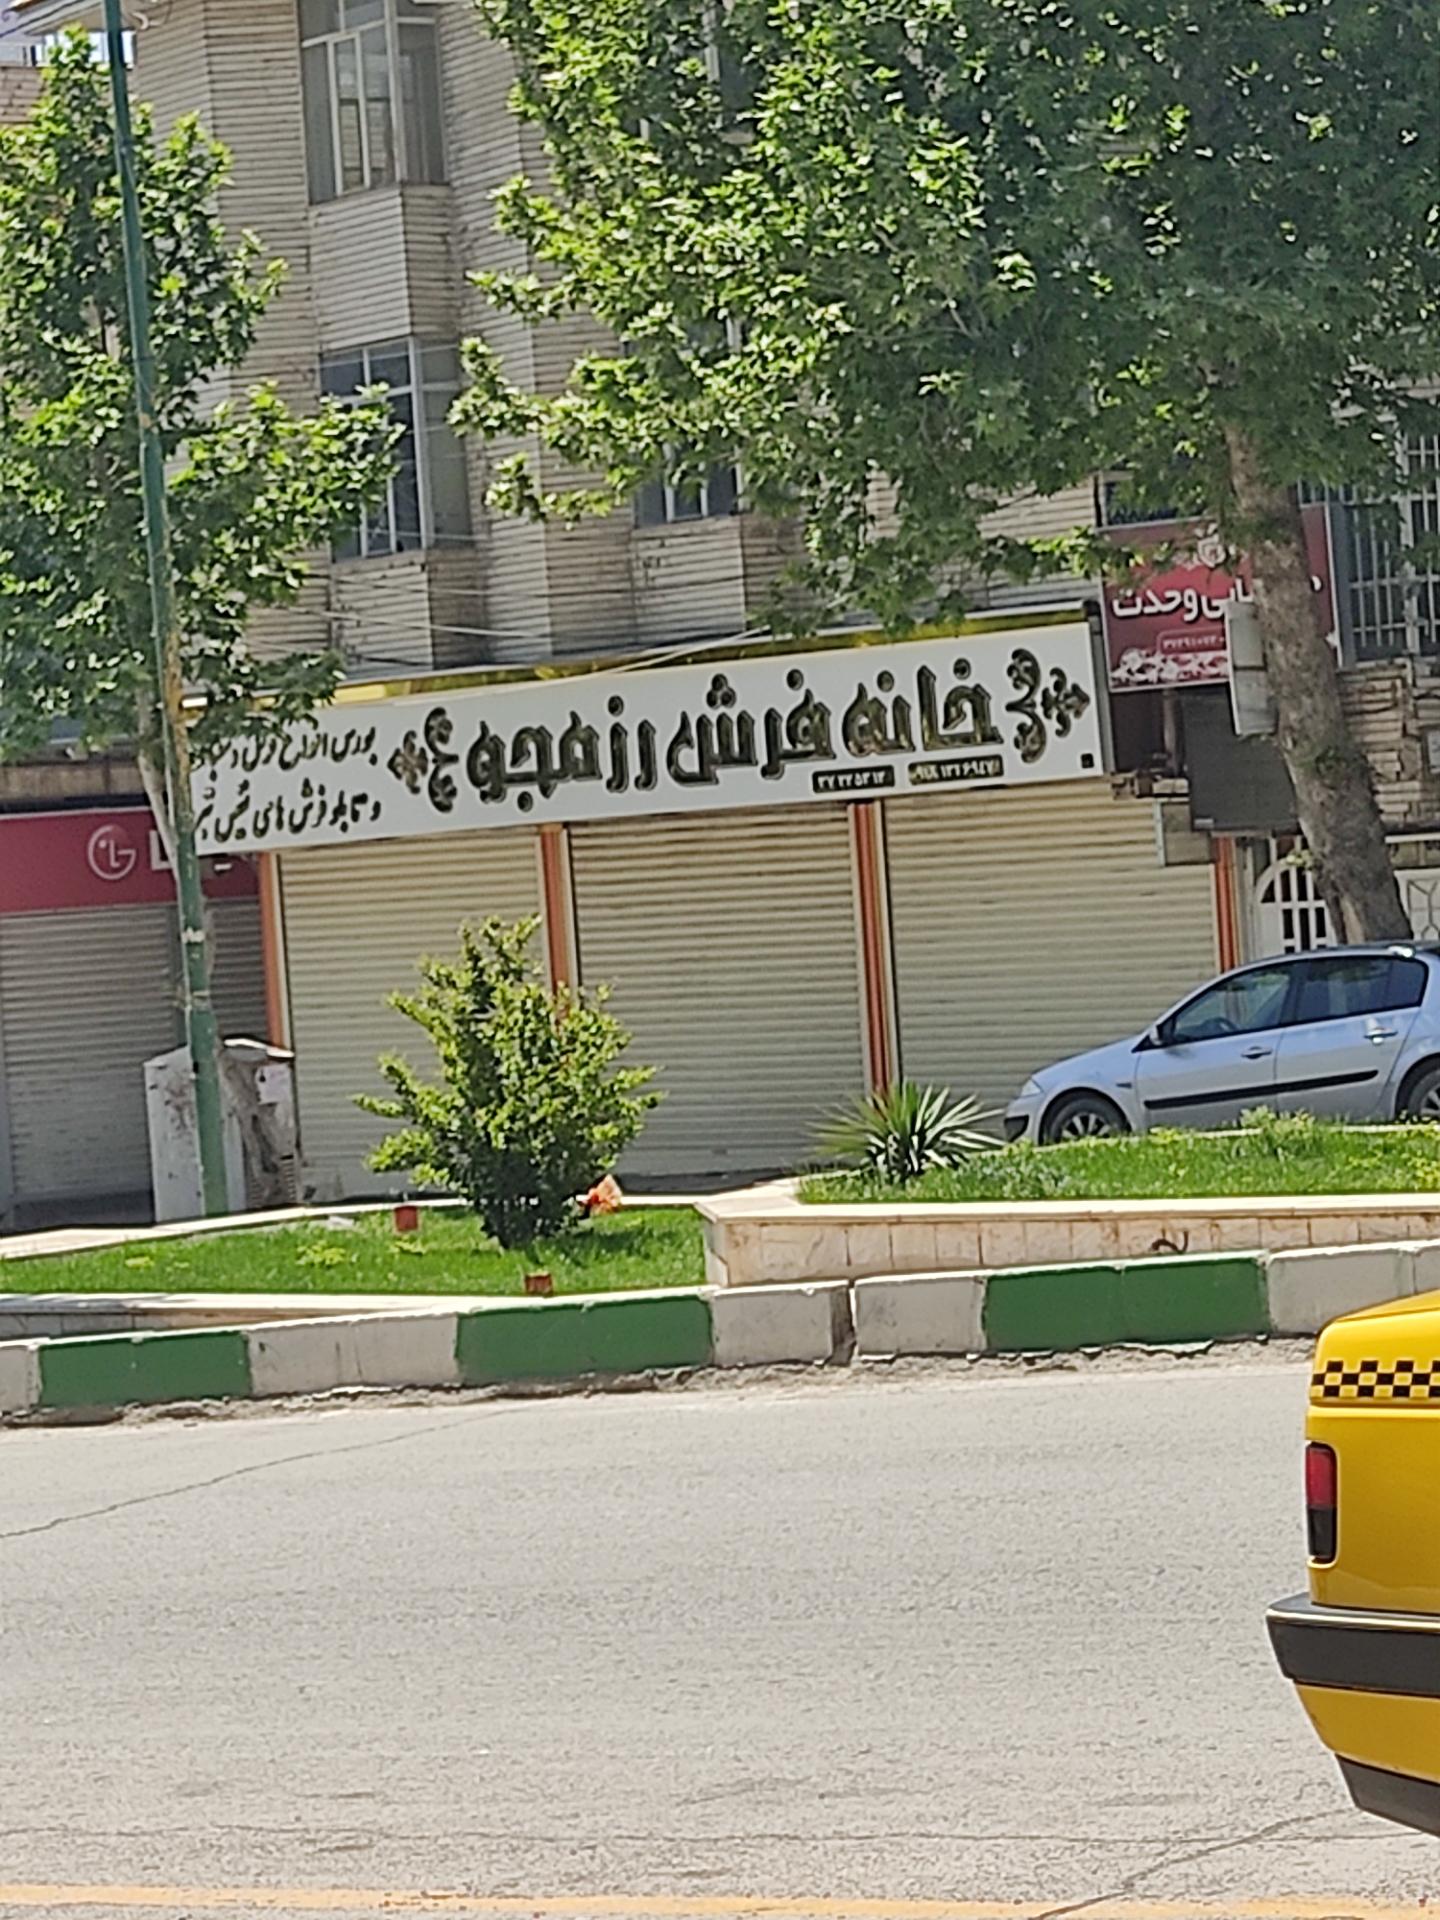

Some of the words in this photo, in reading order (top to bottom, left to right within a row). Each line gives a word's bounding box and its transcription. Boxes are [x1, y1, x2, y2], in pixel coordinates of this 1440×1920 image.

[466, 694, 658, 813] رزمجو
[666, 668, 837, 786] فرش
[842, 657, 1004, 759] خانه
[88, 824, 137, 881] LG
